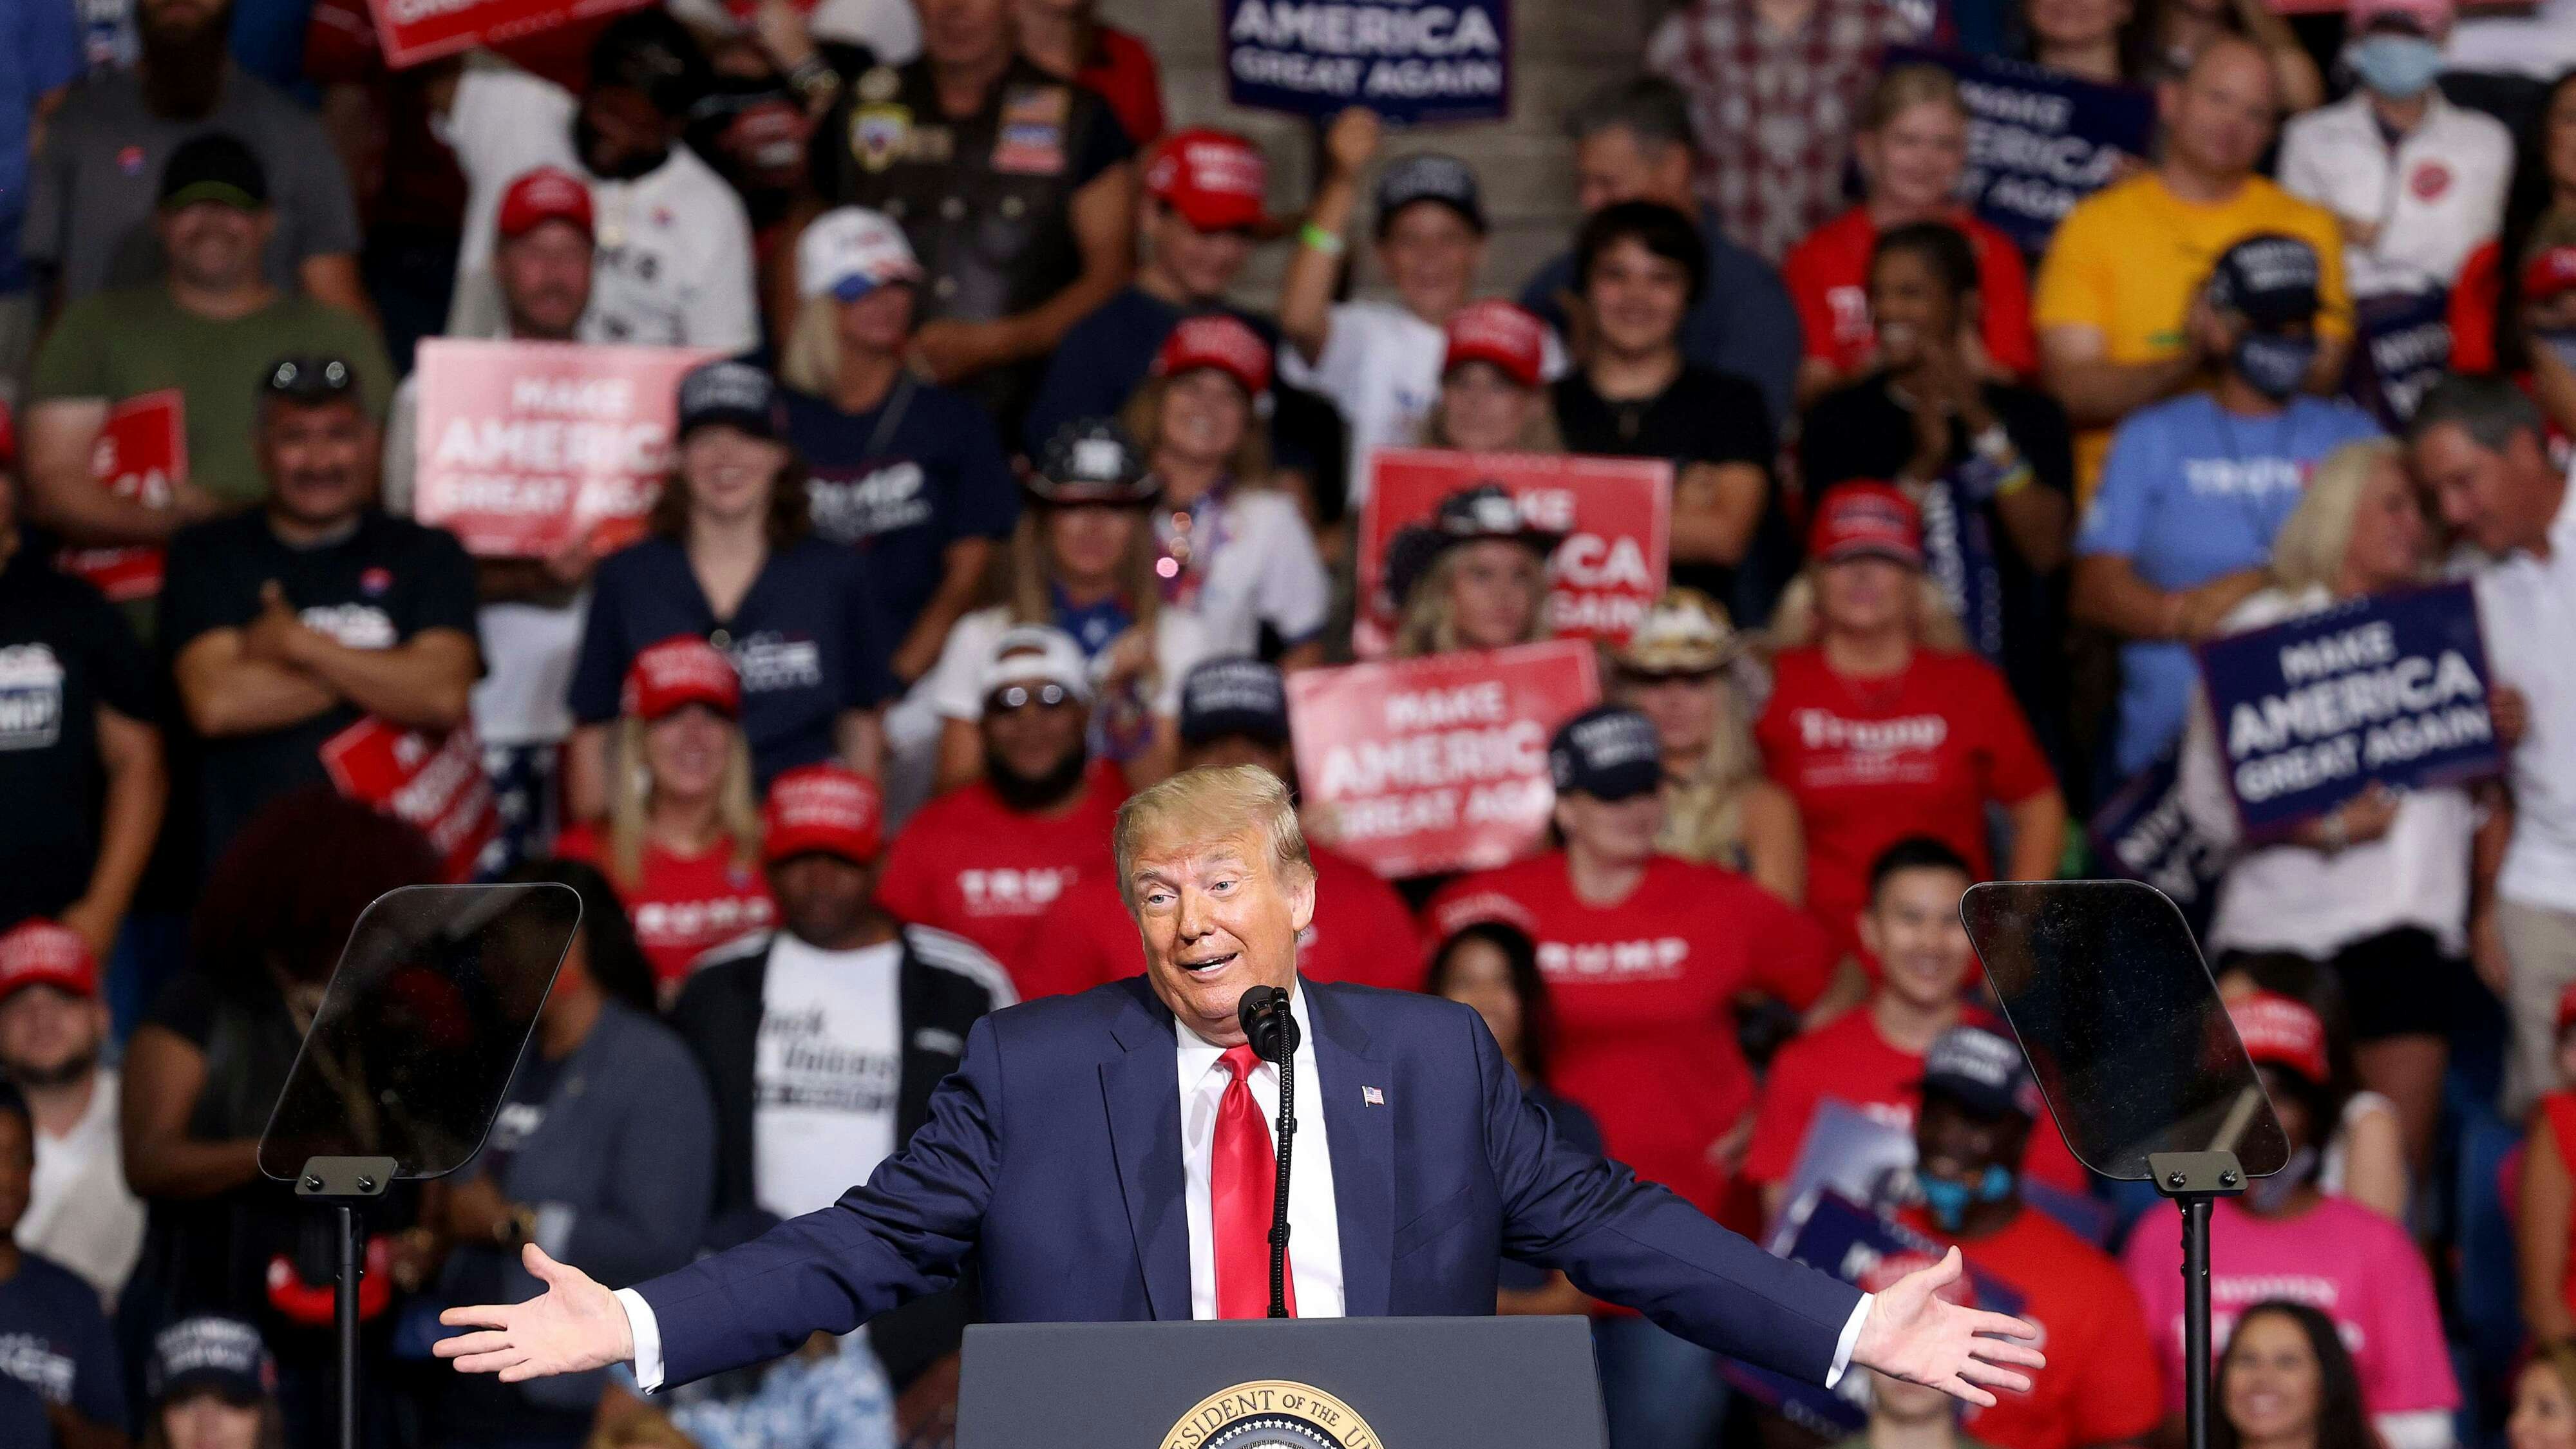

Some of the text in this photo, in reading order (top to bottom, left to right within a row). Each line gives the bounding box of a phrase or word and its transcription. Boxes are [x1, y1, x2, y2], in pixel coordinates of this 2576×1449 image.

[1230, 0, 1502, 55] AMERICA
[1230, 46, 1504, 98] GREAT AGAIN
[513, 375, 634, 417] MAKE
[435, 416, 673, 474] AMERIC
[435, 475, 567, 515] GREAT
[2279, 619, 2397, 685] MAKE
[1385, 679, 1505, 730] MAKE
[2228, 649, 2484, 759] AMERICA
[1316, 719, 1546, 800] AMERIC
[2235, 704, 2493, 803] GREAT AGAIN
[634, 896, 775, 934] RUMP
[1535, 936, 1690, 973] RUMP
[1283, 1394, 1306, 1410] OF
[1311, 1401, 1340, 1427] THE
